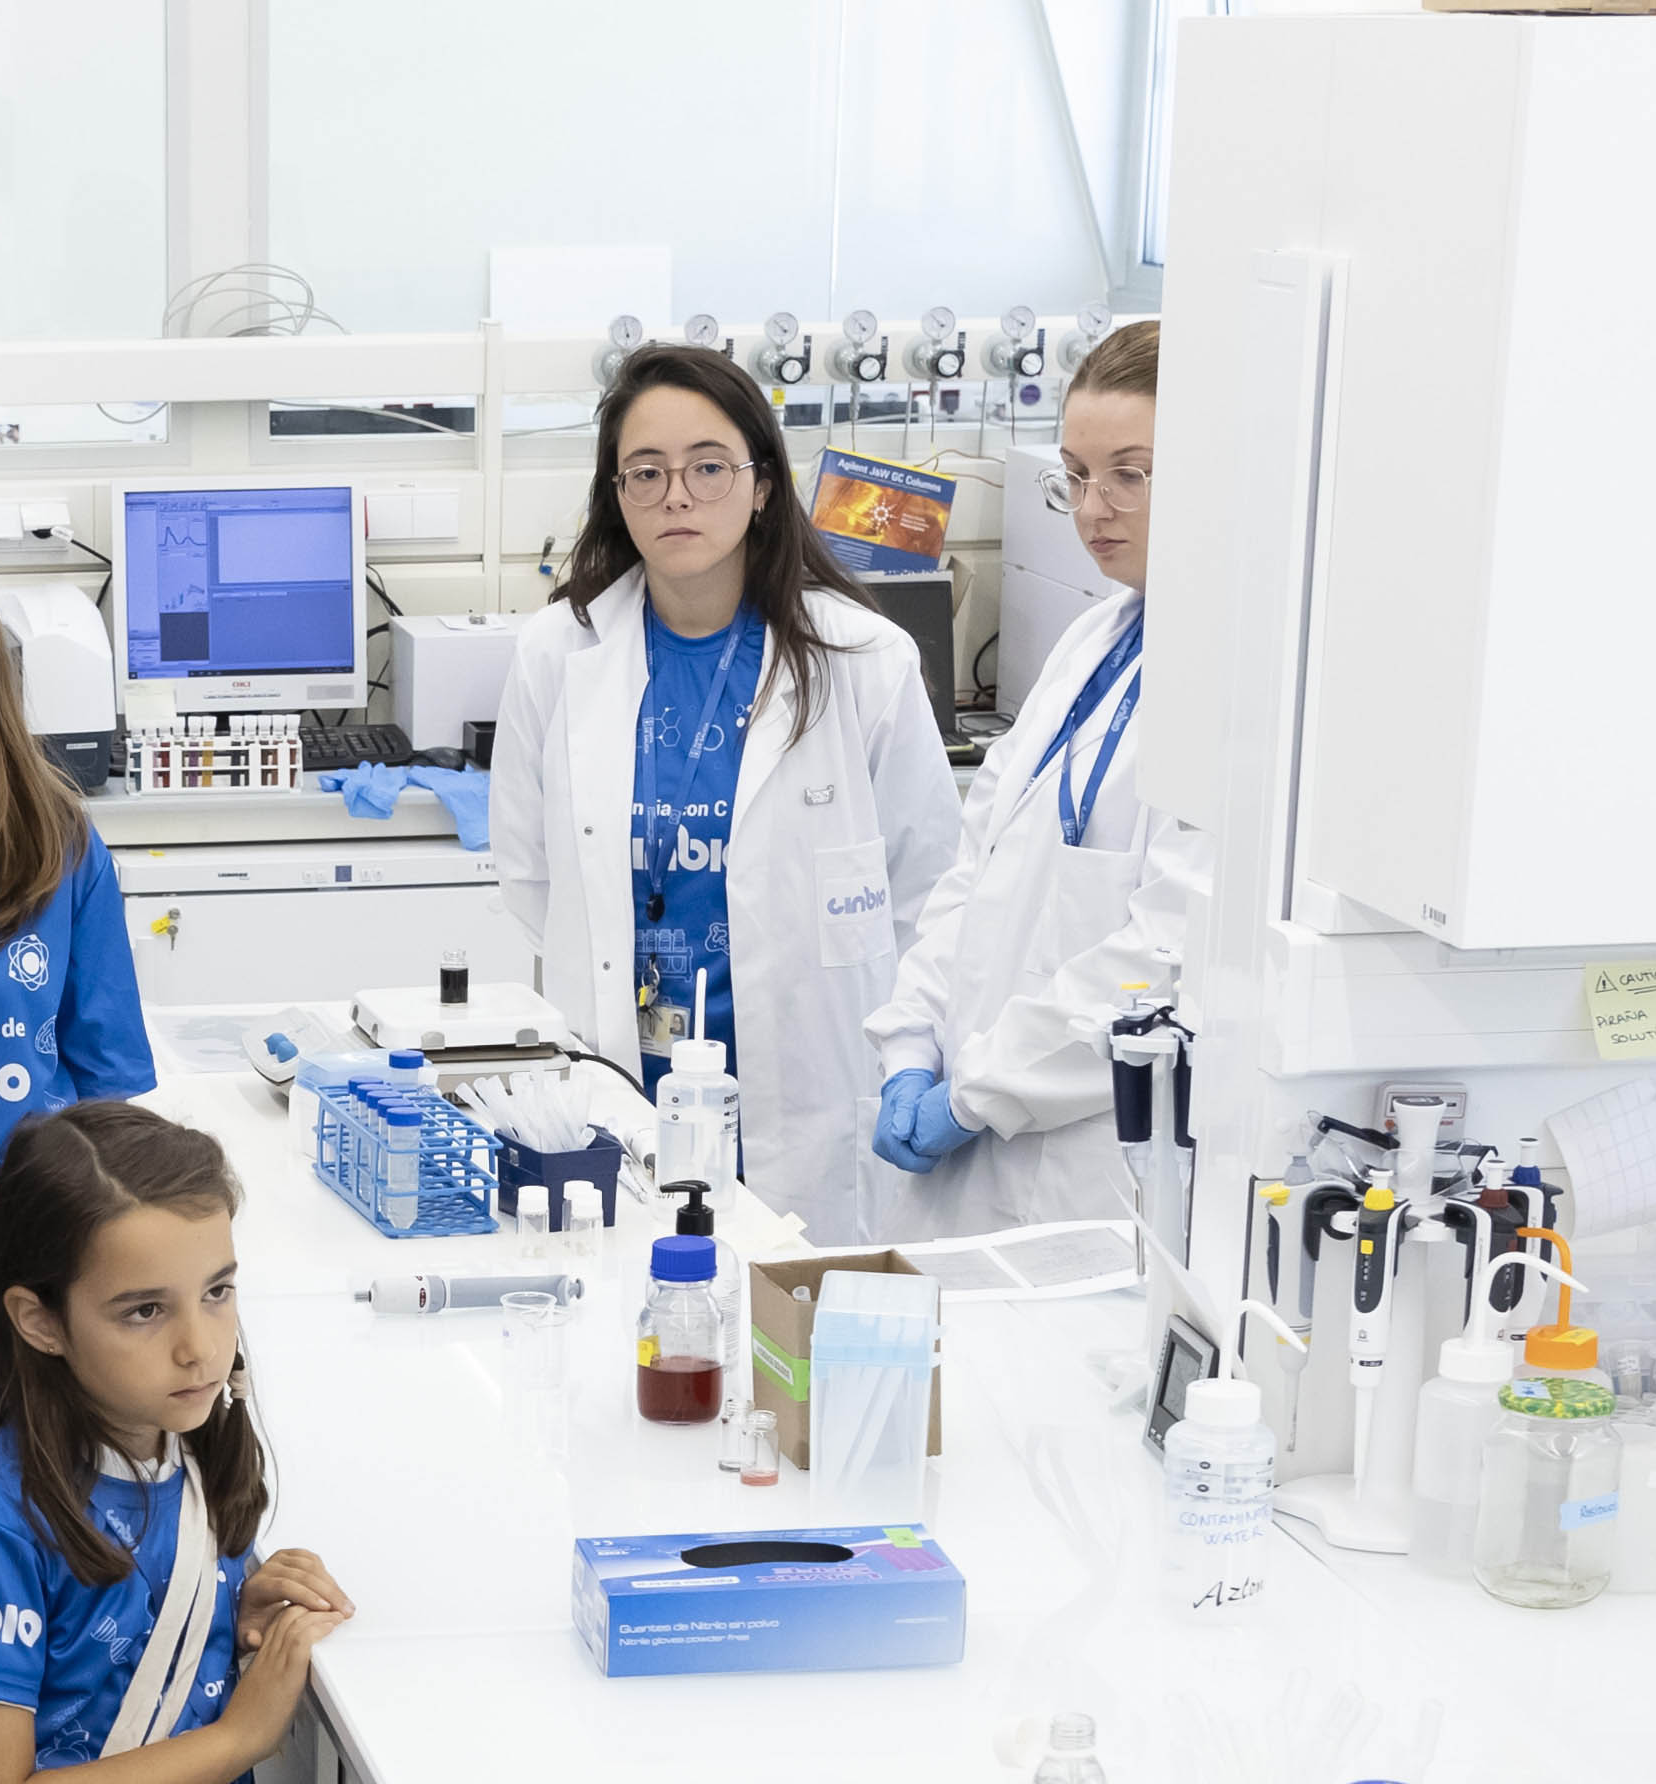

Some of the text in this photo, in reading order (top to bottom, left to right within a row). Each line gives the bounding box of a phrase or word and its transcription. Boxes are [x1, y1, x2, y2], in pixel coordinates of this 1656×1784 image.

[837, 458, 868, 475] Agilent
[891, 472, 904, 483] GC
[905, 476, 942, 493] Columns
[683, 801, 710, 817] on
[714, 800, 728, 817] C
[827, 886, 886, 916] cinbio
[1, 1016, 26, 1038] de
[1203, 1526, 1264, 1545] WATER
[618, 1622, 671, 1635] Guantes
[672, 1621, 688, 1632] de
[690, 1619, 727, 1632] Nitrilo
[747, 1618, 780, 1632] polvo
[618, 1636, 650, 1647] Nitrile
[651, 1635, 684, 1648] gloves
